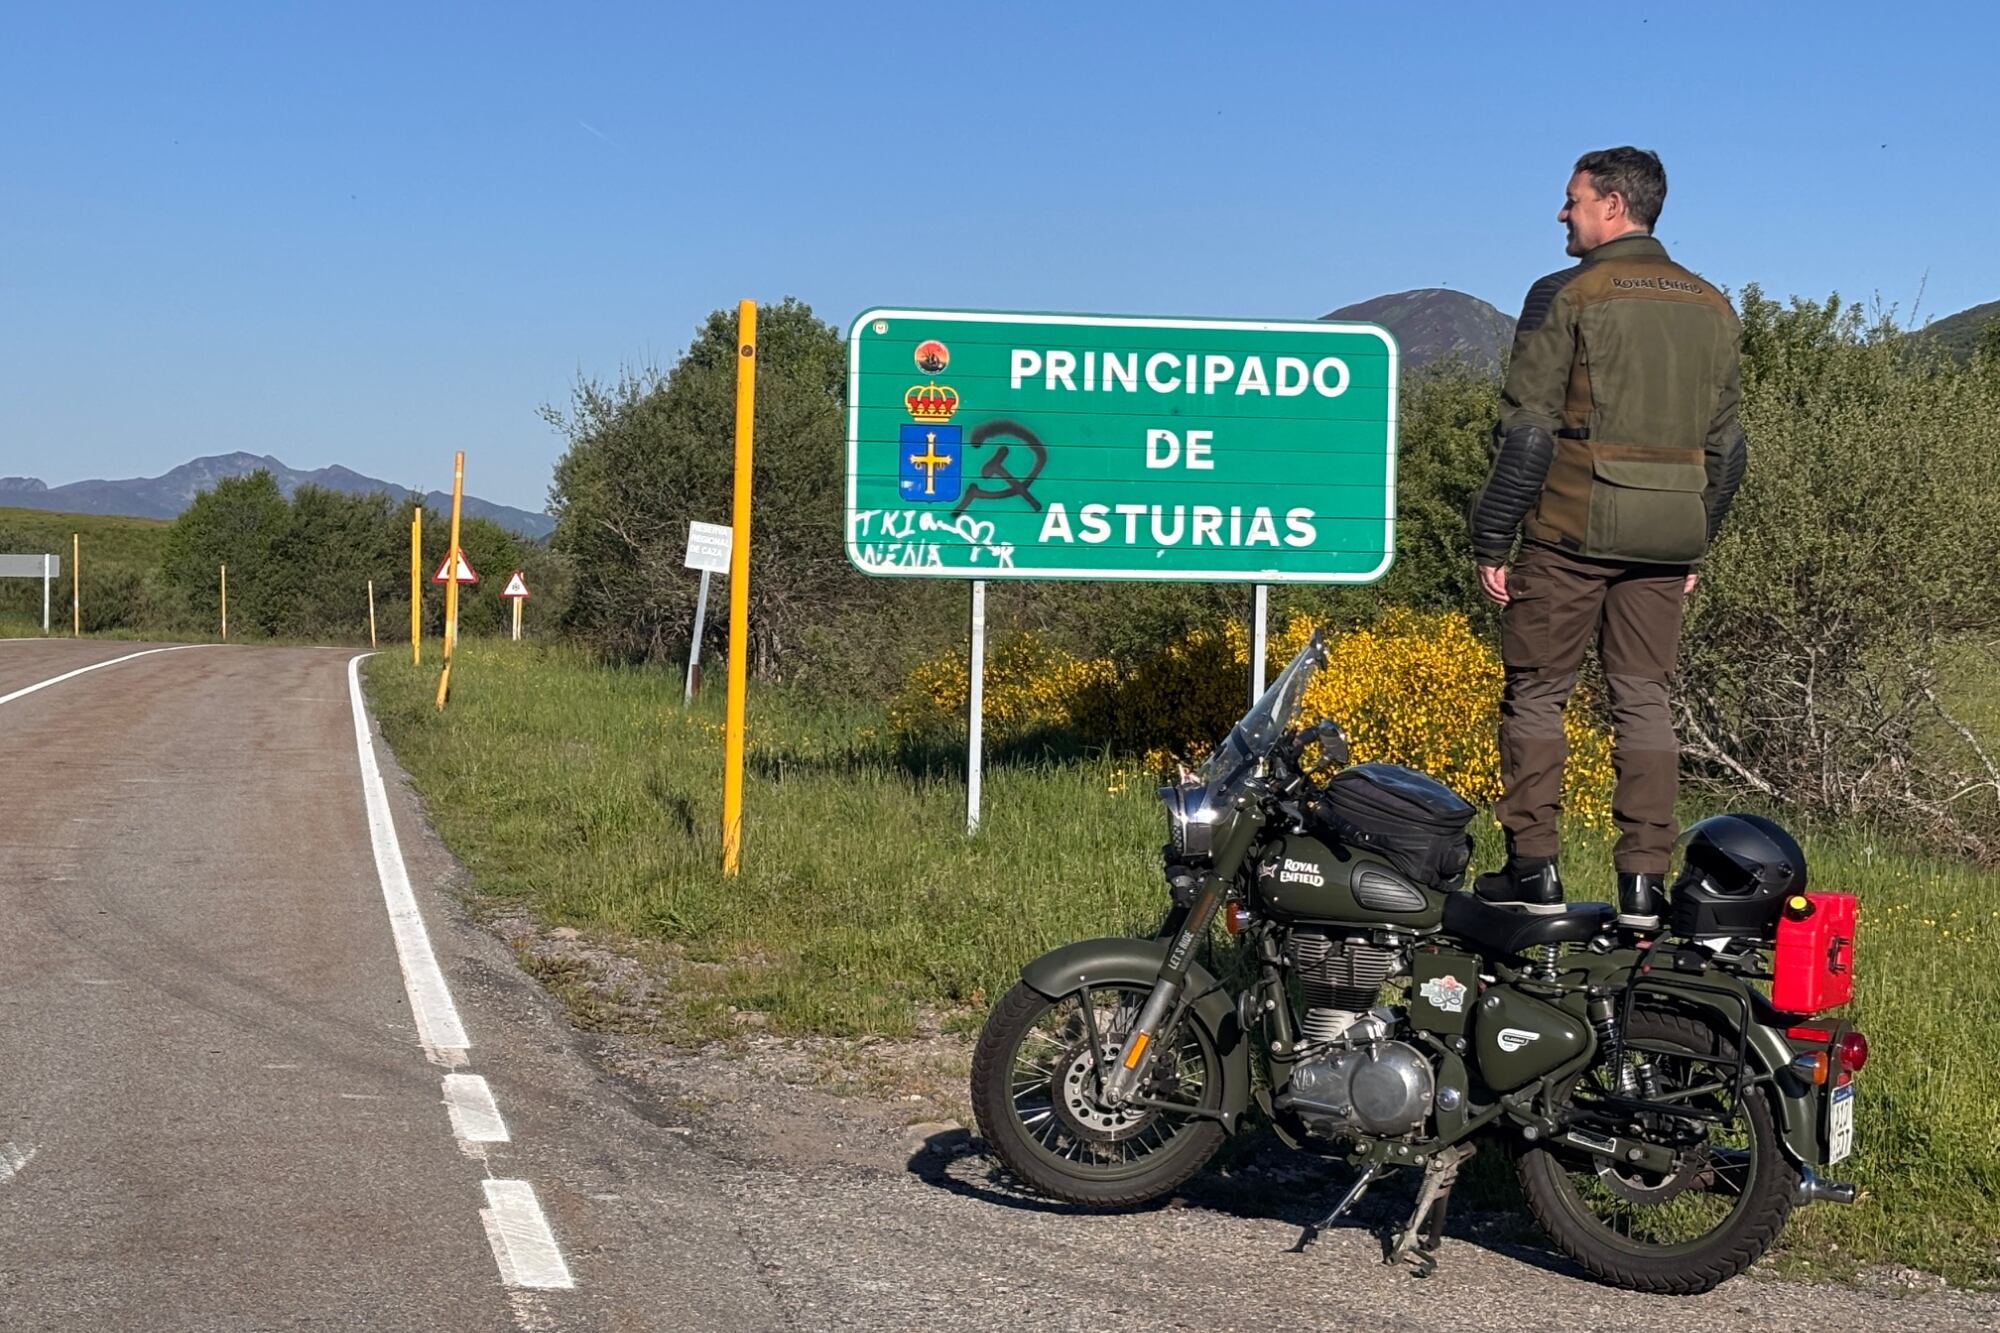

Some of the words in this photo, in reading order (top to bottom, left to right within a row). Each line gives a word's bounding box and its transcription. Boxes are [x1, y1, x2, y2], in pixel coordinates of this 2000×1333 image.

[1611, 278, 1655, 290] ROYAL
[1656, 277, 1703, 295] ENFIELD
[1010, 349, 1351, 397] PRINCIPADO
[1145, 429, 1214, 470] DE
[1038, 502, 1317, 547] ASTURIAS
[1280, 870, 1325, 887] ENFIELD
[1284, 858, 1320, 874] ROYAL
